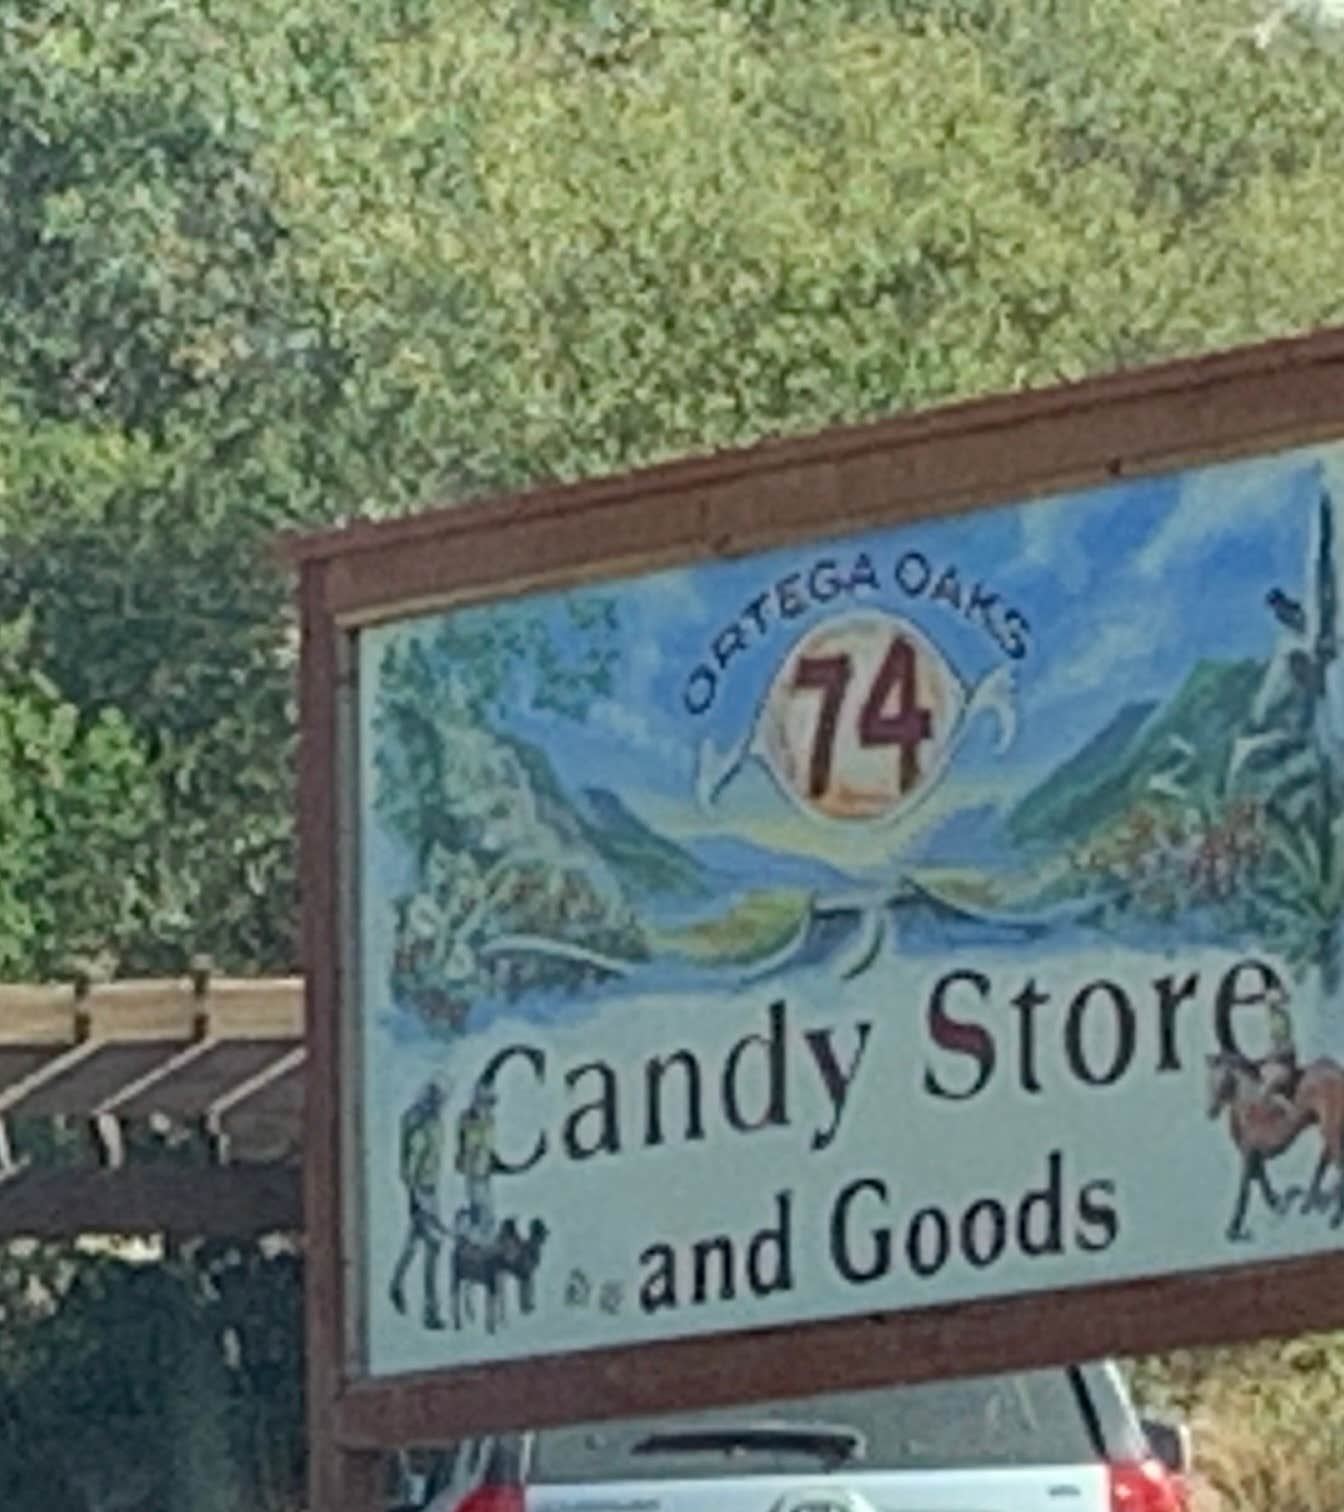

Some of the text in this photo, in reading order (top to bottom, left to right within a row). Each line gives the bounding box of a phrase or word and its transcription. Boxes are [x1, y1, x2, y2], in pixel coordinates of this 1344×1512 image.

[682, 550, 1032, 716] ORTEGA OAKS
[792, 632, 934, 800] 74
[472, 959, 1293, 1176] Candy Store
[638, 1148, 1120, 1315] and Goods
